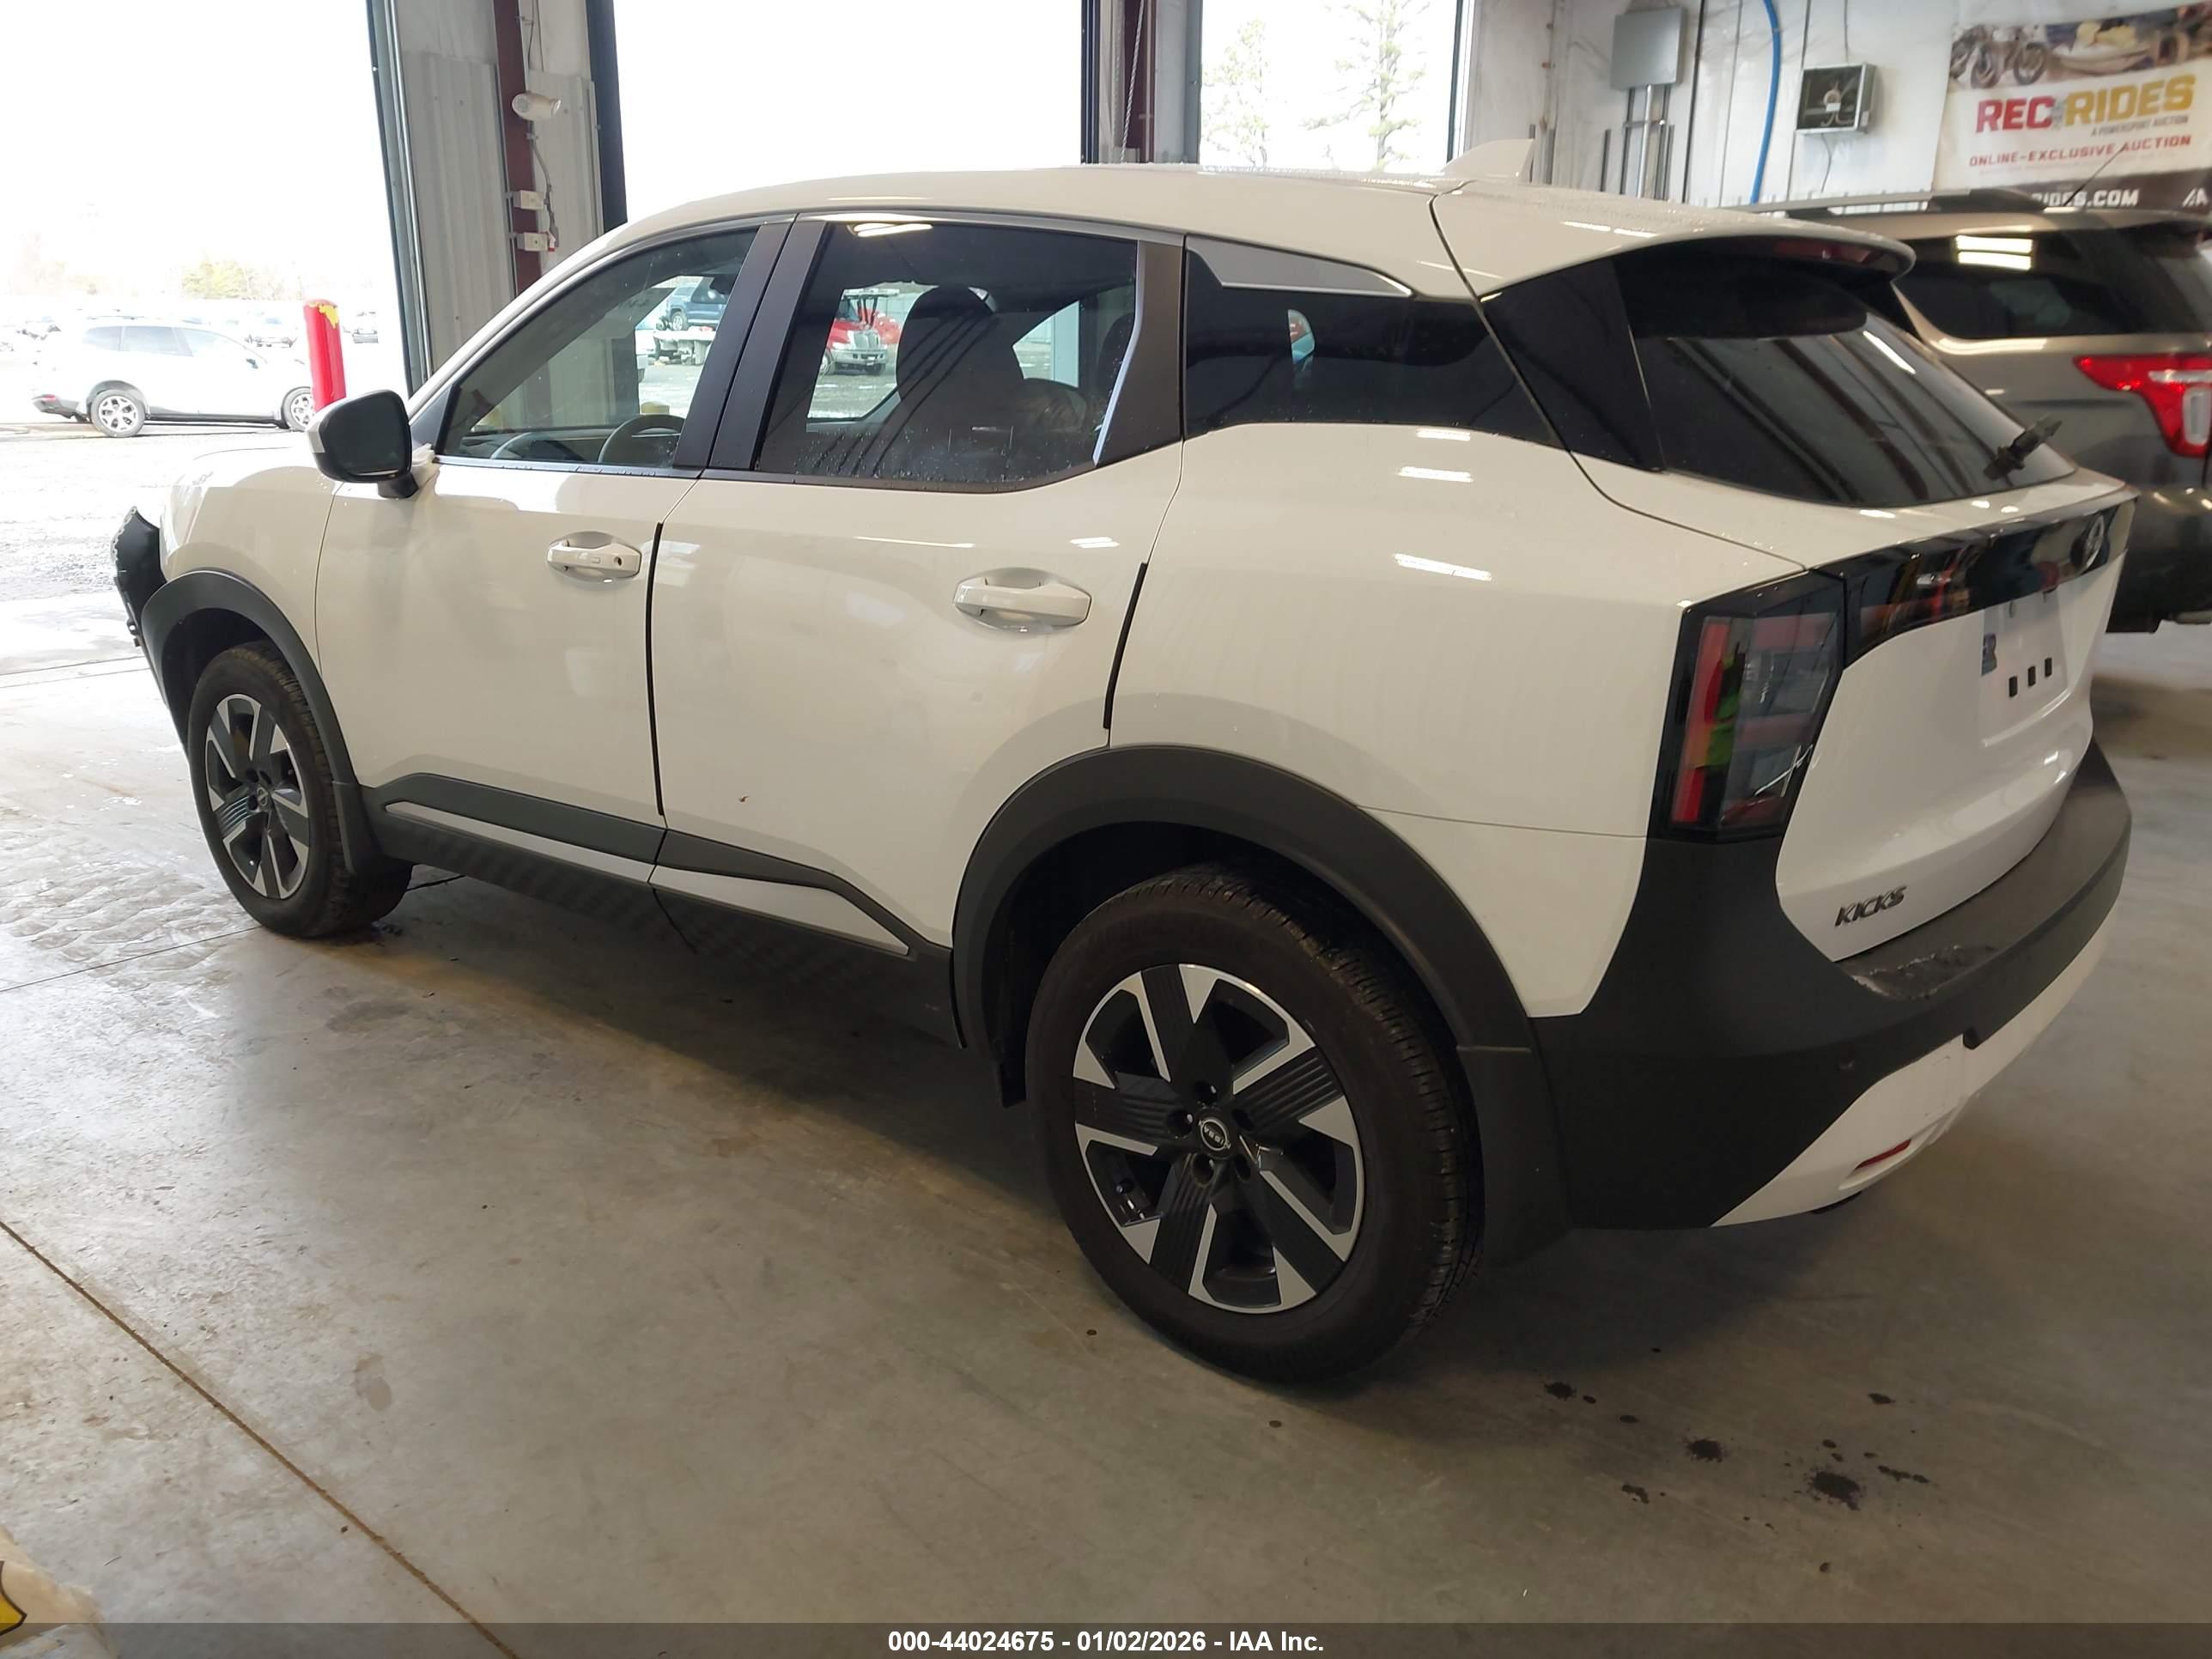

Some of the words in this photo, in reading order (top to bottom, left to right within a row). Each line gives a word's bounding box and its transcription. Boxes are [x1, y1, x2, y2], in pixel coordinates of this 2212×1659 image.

[1976, 95, 2056, 133] REC
[2064, 75, 2196, 126] RIDES
[1969, 143, 2117, 167] ONLINE-EXCLUSIVE
[2119, 135, 2191, 153] AUCTION
[1834, 885, 1907, 927] KICKS
